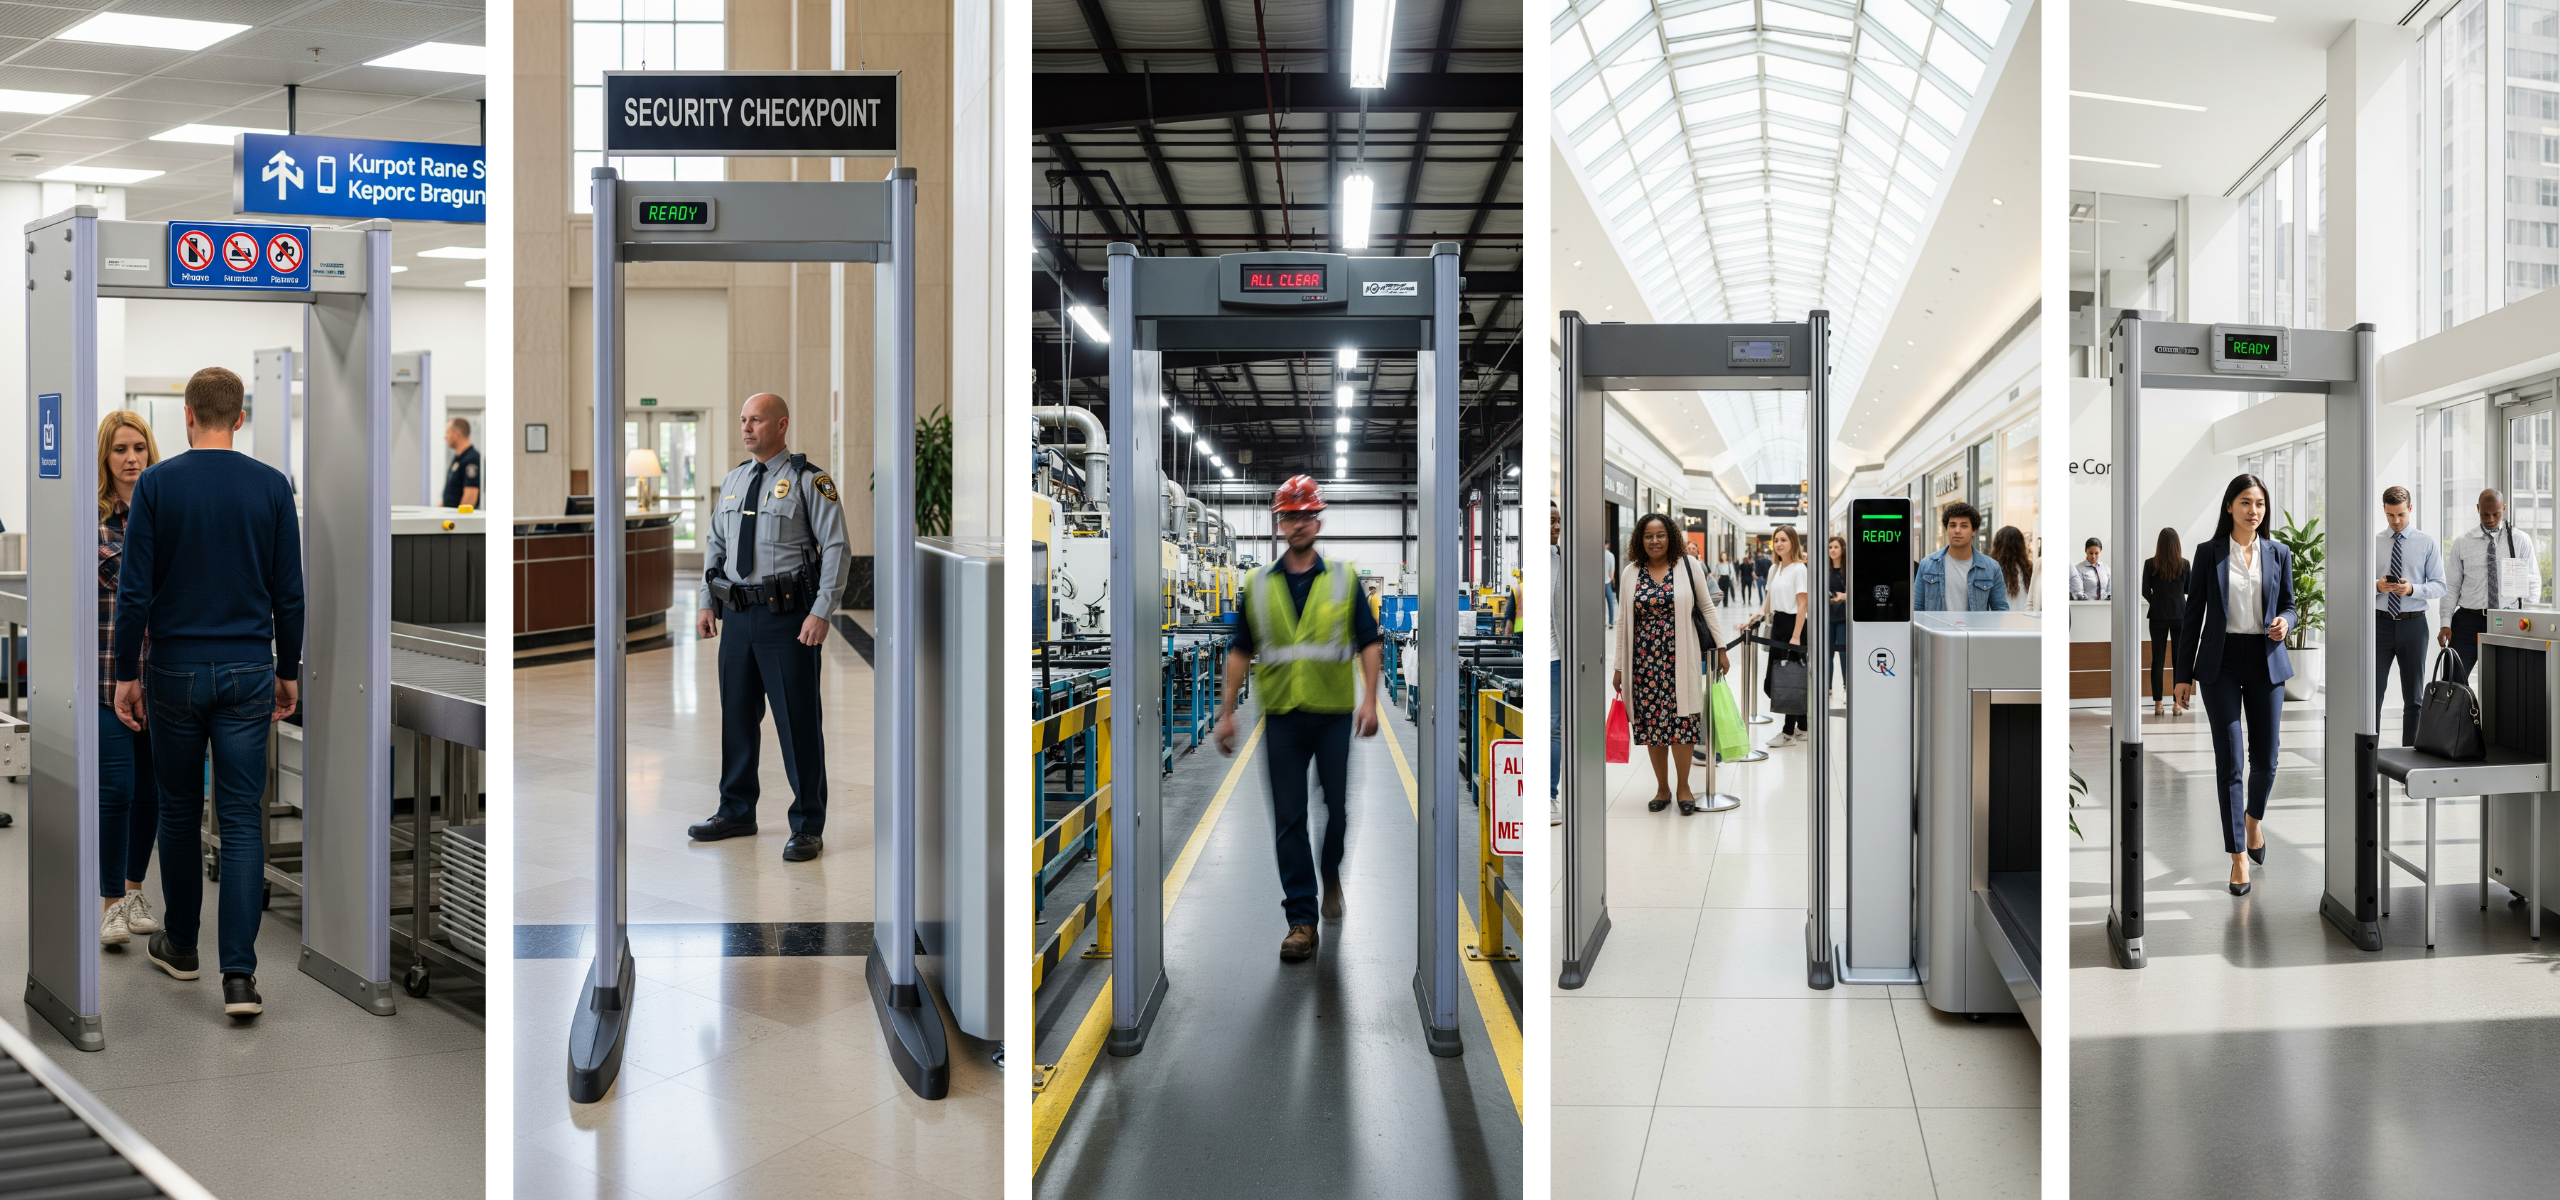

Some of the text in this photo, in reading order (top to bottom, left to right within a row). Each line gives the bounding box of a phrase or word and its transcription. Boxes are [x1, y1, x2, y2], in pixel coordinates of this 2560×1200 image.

[624, 97, 881, 127] SECURITY CHECKPOINT
[349, 153, 486, 179] Kurpot Rane S
[348, 180, 416, 205] Keporc
[648, 205, 698, 221] READY
[1251, 274, 1320, 287] ALL CLEAR
[2233, 341, 2270, 355] READY
[1862, 530, 1901, 543] READY
[1503, 757, 1524, 775] AL
